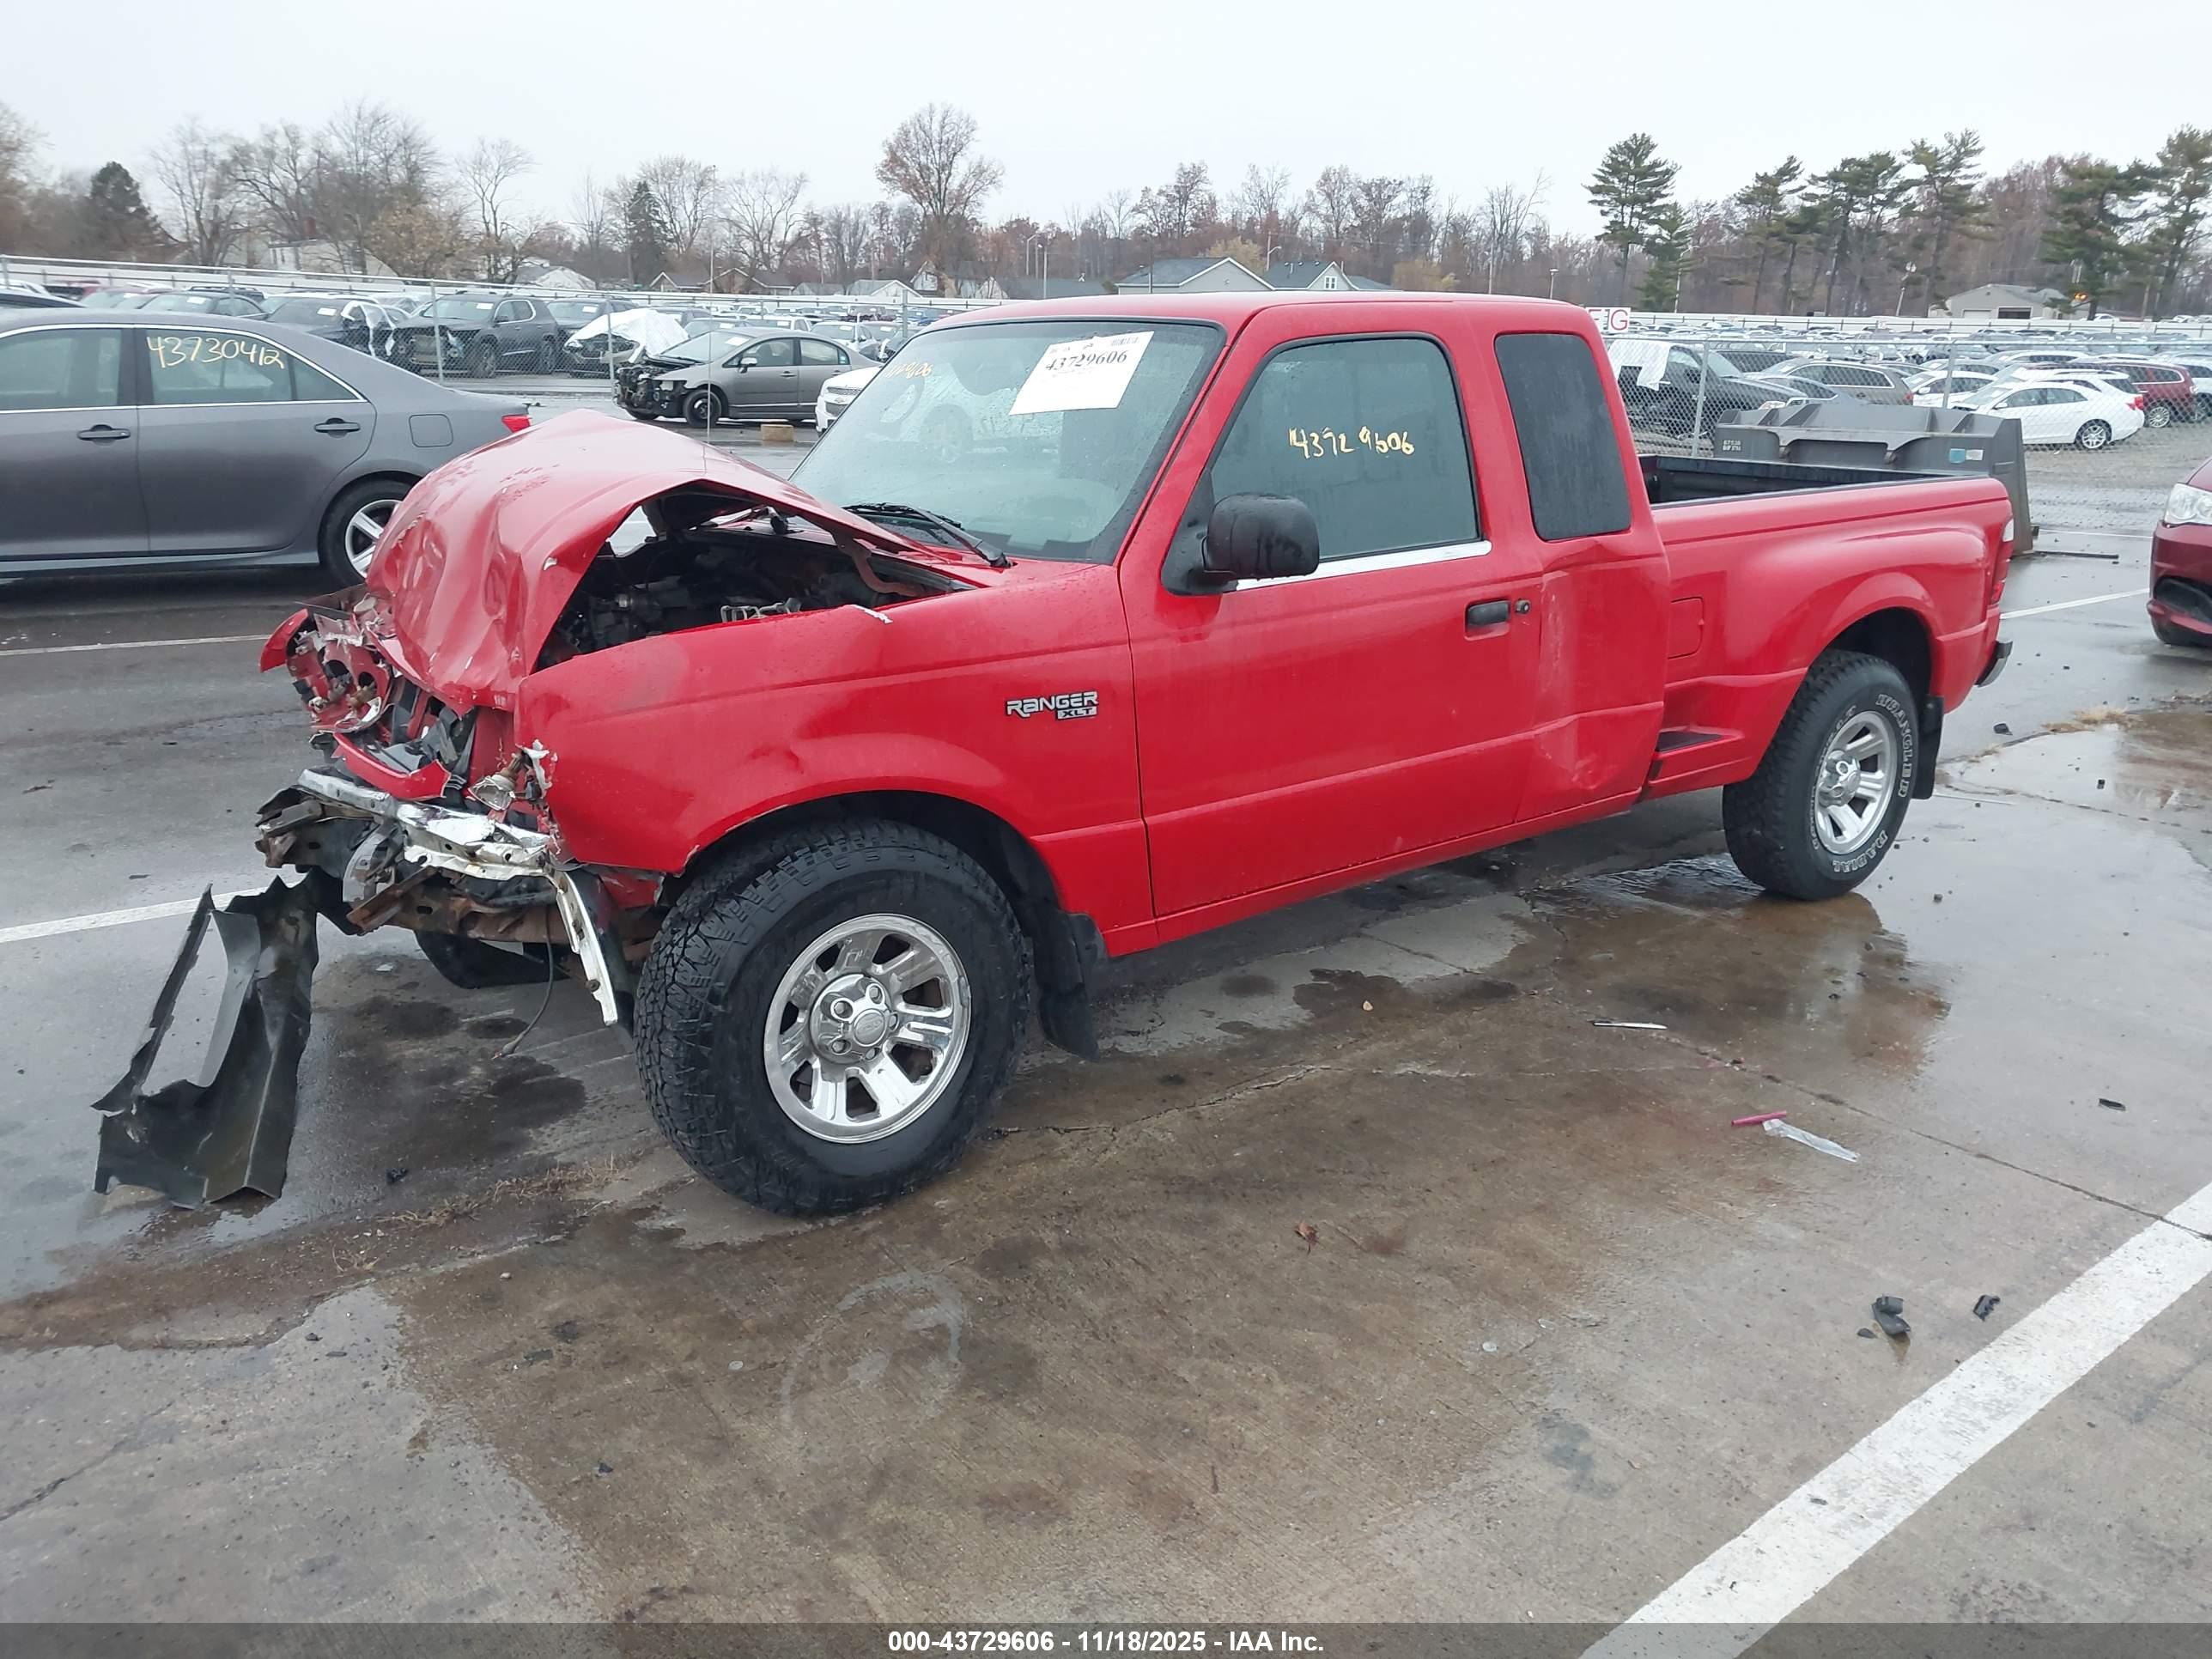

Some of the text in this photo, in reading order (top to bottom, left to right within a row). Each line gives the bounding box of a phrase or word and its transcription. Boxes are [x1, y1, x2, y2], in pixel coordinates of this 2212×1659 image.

[146, 336, 285, 369] 43730412
[1045, 349, 1127, 371] 43729606
[1007, 691, 1098, 718] RANGER
[1060, 707, 1095, 718] XLT
[1875, 694, 1913, 797] WRANGLER
[1832, 830, 1888, 873] RADIAL
